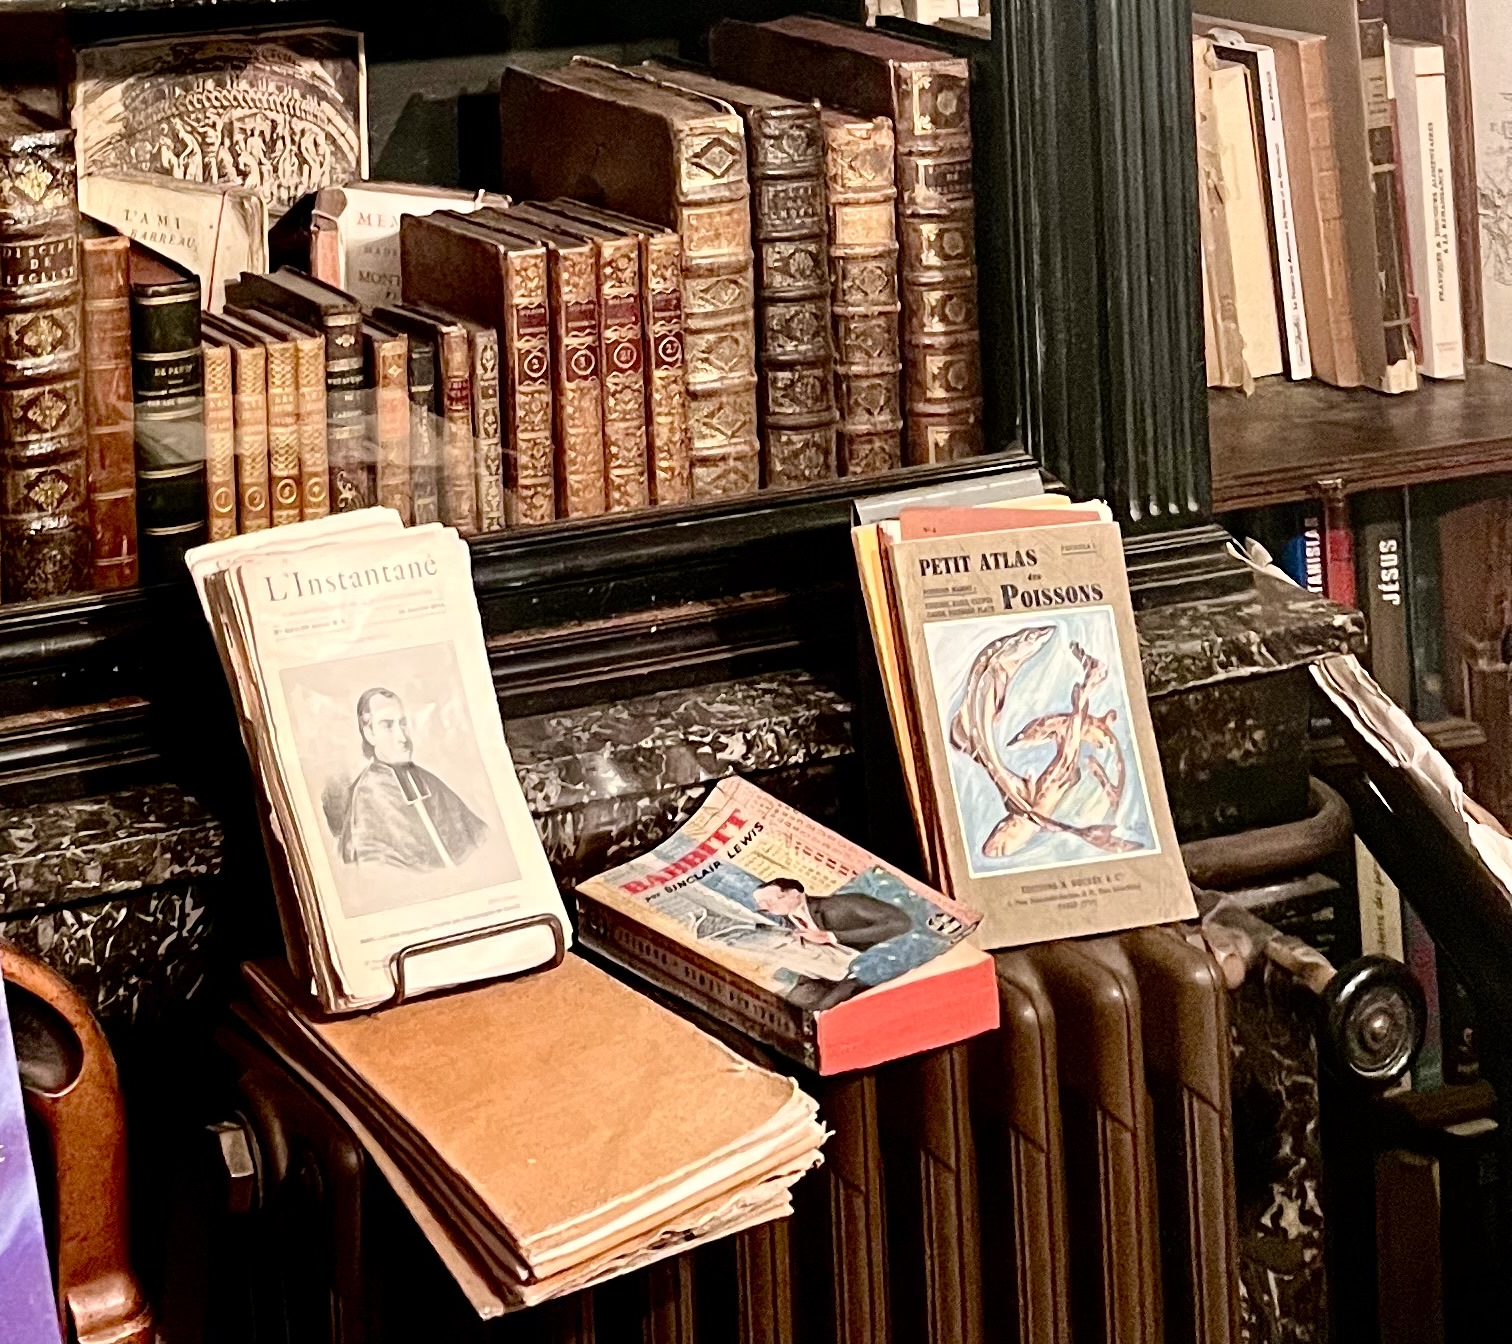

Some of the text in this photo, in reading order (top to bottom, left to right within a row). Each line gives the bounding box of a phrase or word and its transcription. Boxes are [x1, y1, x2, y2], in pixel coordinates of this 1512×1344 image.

[265, 553, 438, 602] L'Instantané
[919, 556, 971, 577] PETIT
[979, 549, 1038, 571] ATLAS
[1377, 539, 1401, 605] JÉSUS
[619, 808, 749, 896] BABBITT
[664, 820, 765, 895] SINCLAIR LEWIS
